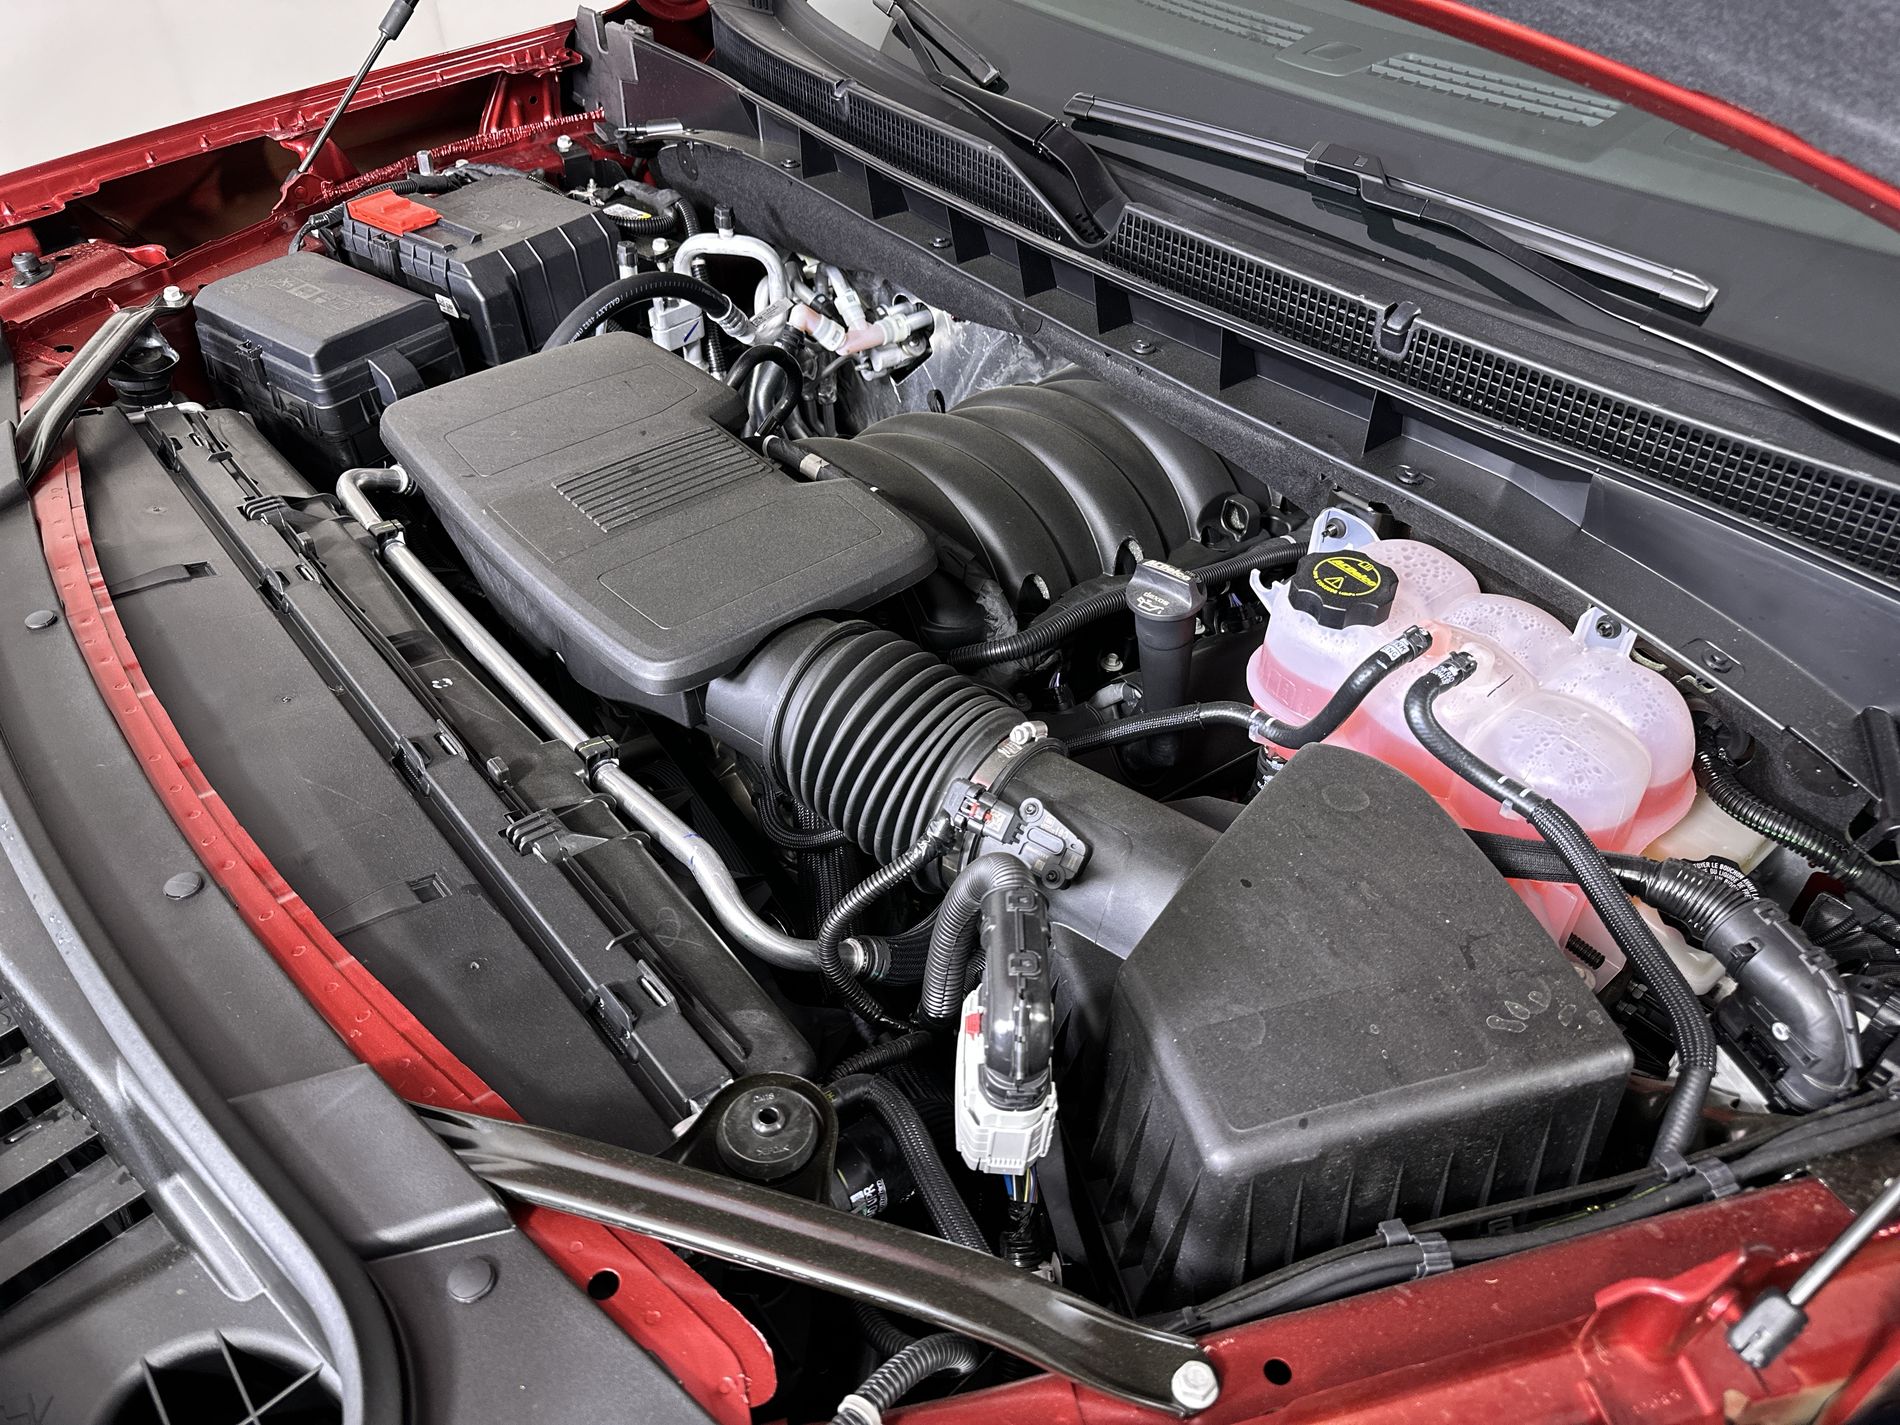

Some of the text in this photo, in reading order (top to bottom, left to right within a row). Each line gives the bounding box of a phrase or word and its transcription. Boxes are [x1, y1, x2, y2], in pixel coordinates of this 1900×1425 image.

[595, 297, 620, 319] GALAXY
[1143, 591, 1170, 606] dexos
[1719, 863, 1745, 880] BOUCHON
[1742, 878, 1758, 893] AVANT
